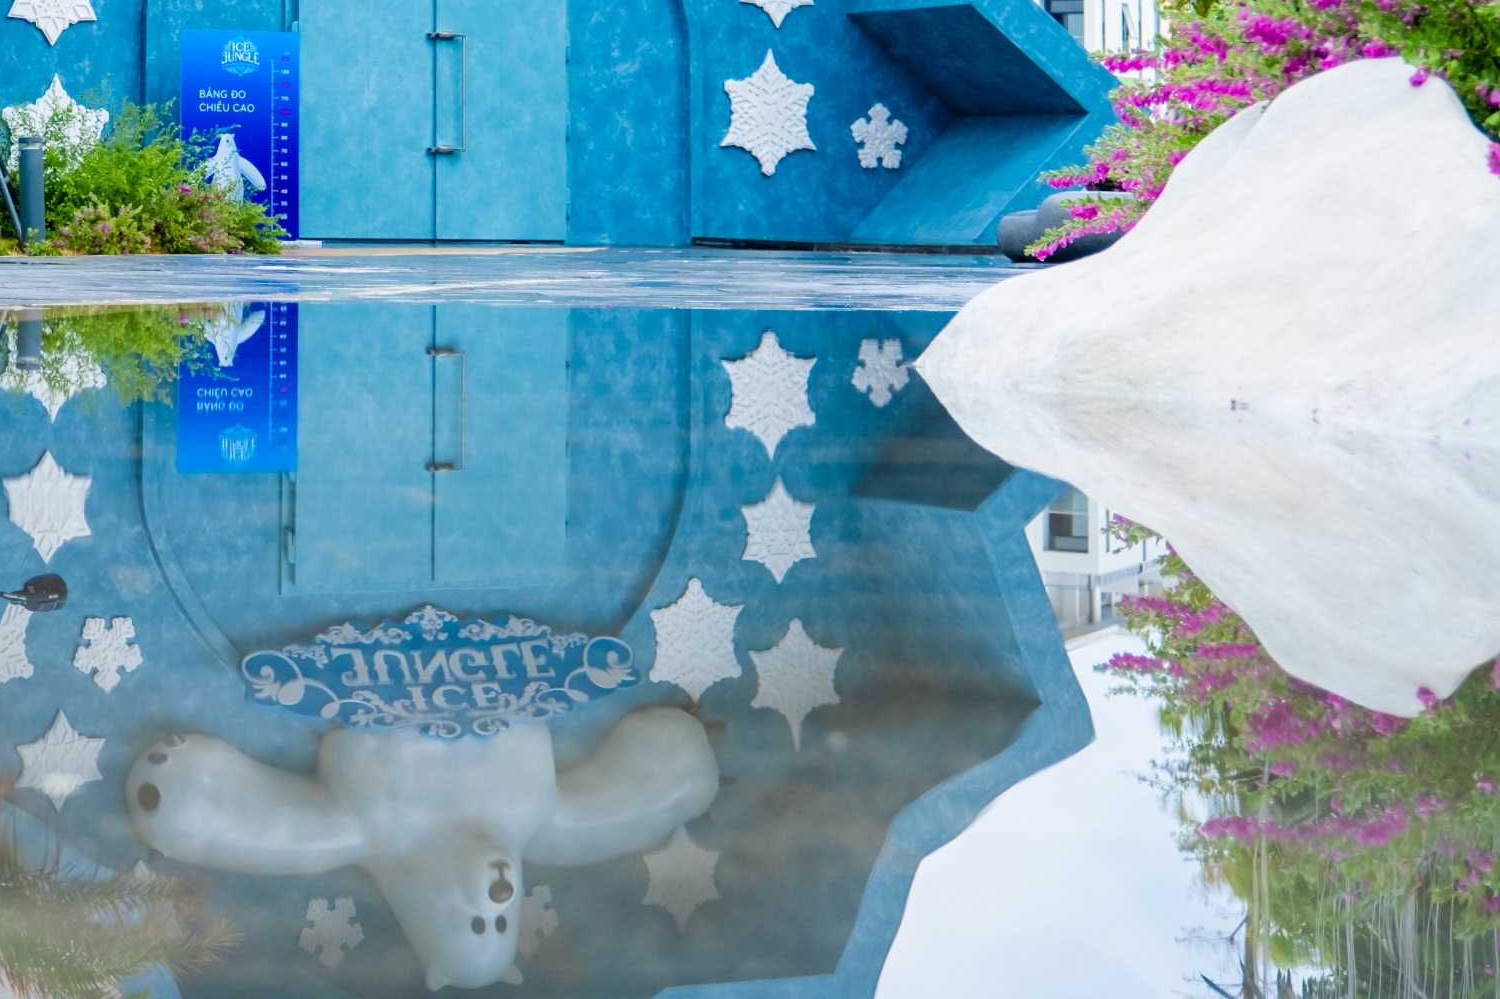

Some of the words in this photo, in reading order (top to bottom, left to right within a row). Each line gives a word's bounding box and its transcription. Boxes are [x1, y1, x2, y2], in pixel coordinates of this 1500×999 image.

[231, 41, 250, 52] ICE
[221, 50, 260, 65] JUNGLE
[199, 86, 227, 99] BẢNG
[230, 90, 246, 99] ĐO
[199, 100, 230, 112] CHIỀU
[232, 103, 255, 113] CAO
